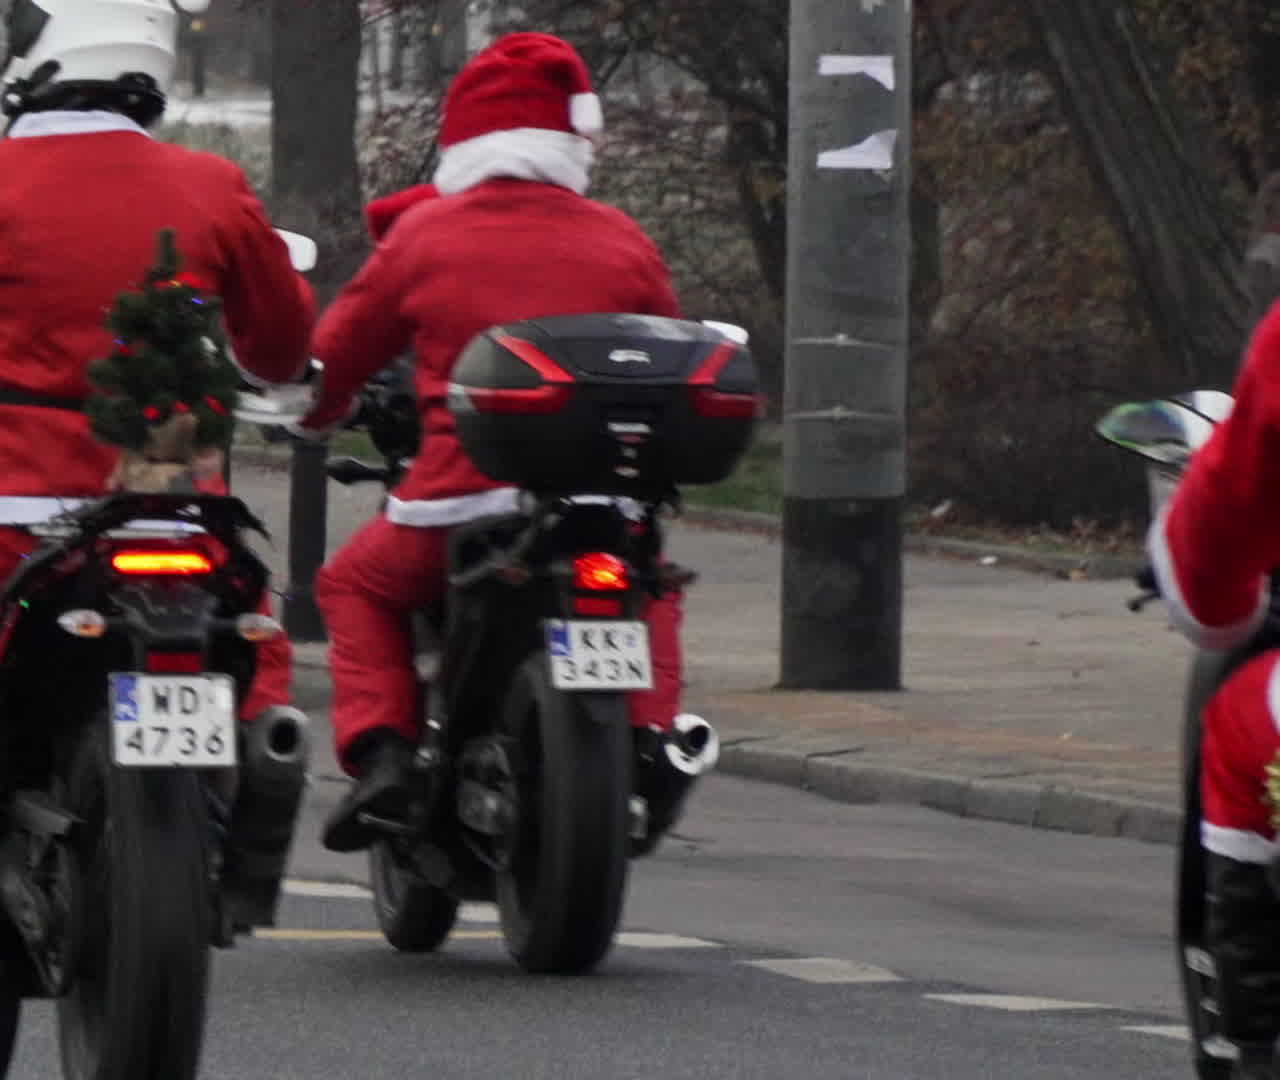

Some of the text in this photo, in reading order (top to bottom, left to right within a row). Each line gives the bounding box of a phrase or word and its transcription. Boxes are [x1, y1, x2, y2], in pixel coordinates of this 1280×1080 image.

[581, 628, 621, 652] KK
[561, 659, 643, 682] 343N
[151, 684, 199, 715] WD
[125, 724, 225, 757] 4736
